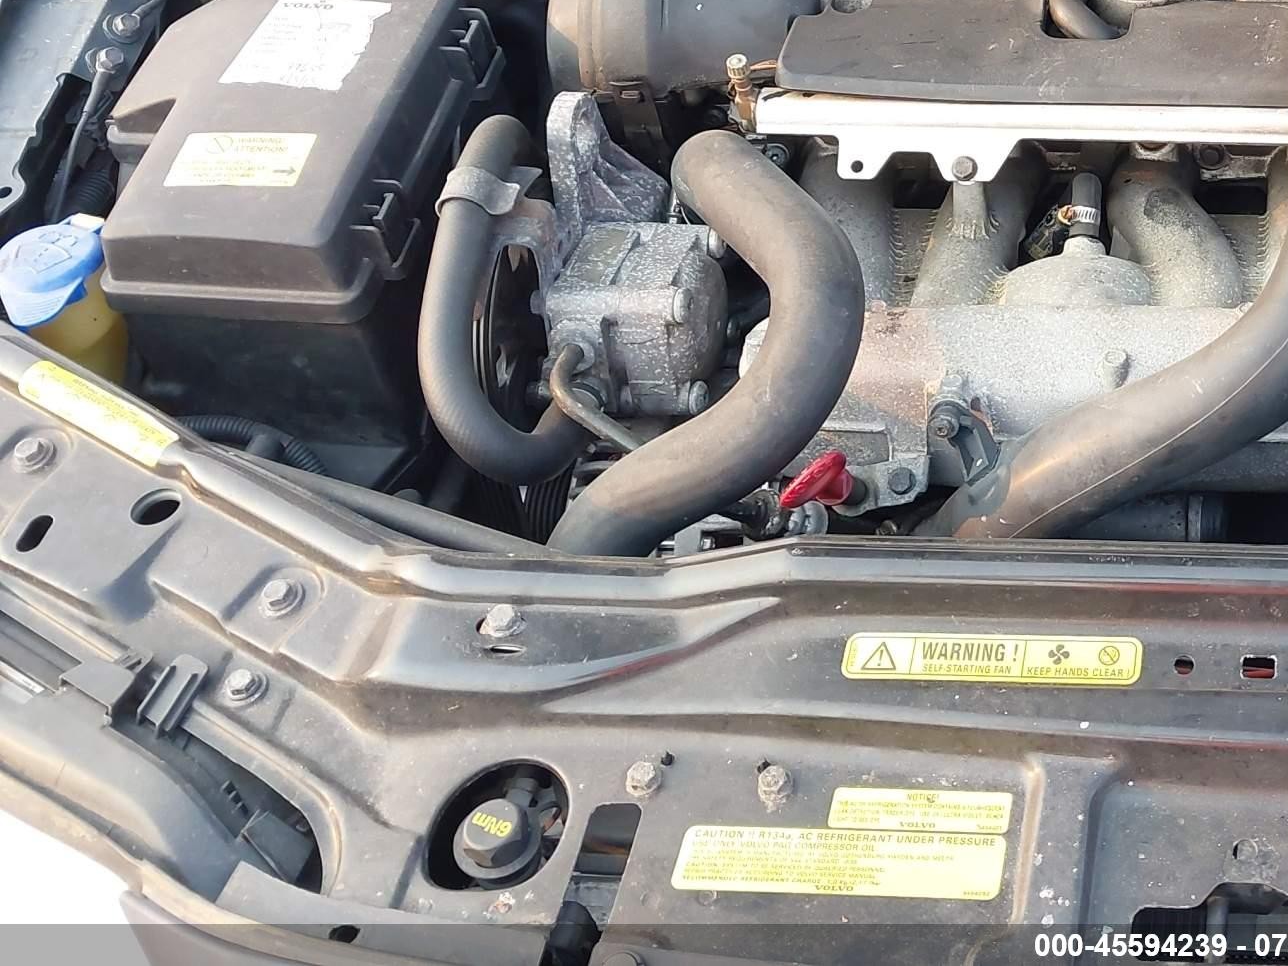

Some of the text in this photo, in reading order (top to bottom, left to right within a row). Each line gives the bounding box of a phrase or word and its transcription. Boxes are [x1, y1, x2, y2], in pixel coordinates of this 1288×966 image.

[283, 2, 335, 10] VOLVO
[922, 642, 1006, 662] WARNING
[921, 664, 1012, 674] SELF-STARTING FAN
[1027, 666, 1051, 676] KEEP
[1054, 667, 1089, 677] HANDS
[1092, 668, 1124, 678] CLEAR
[472, 812, 512, 837] 6Nm
[695, 830, 744, 838] CAUTION
[798, 832, 813, 840] AC
[816, 832, 892, 843] REFRIGERANT
[896, 835, 934, 844] UNDER
[938, 836, 996, 846] PRESSURE
[794, 842, 858, 851] COMPRESSOR
[862, 844, 876, 852] OIL
[814, 884, 854, 892] VOLVO
